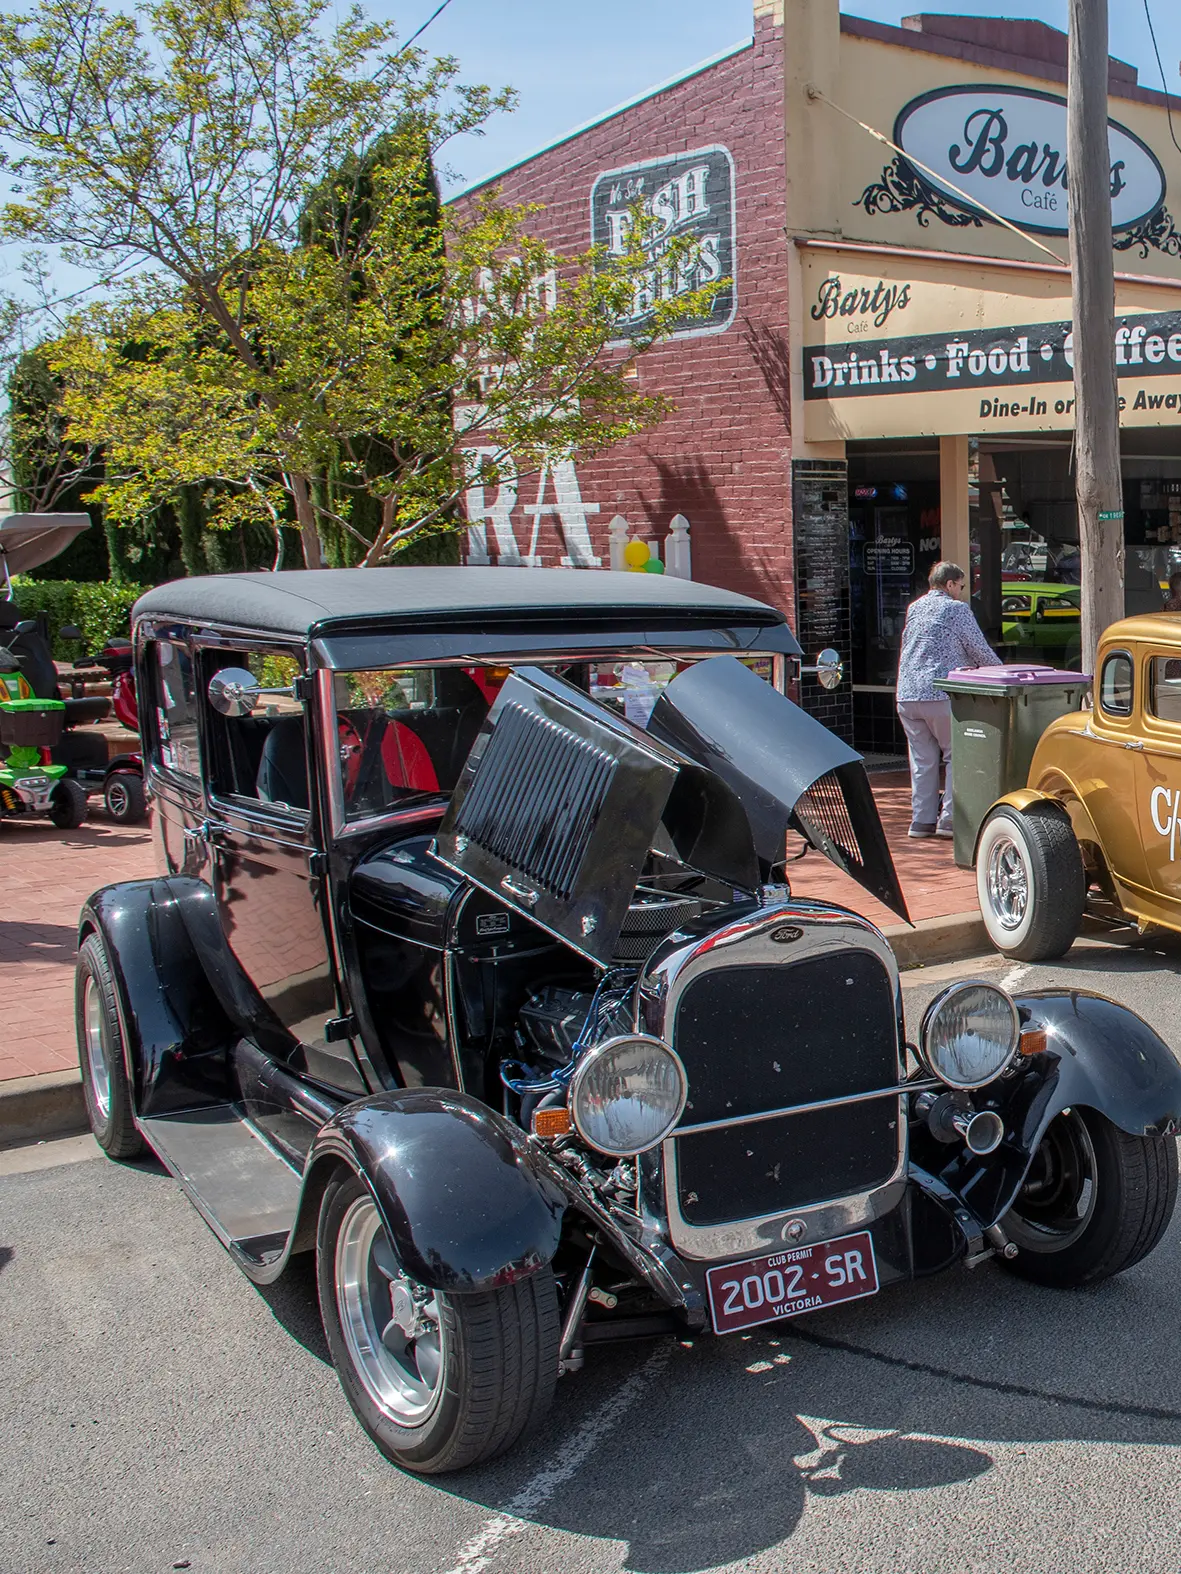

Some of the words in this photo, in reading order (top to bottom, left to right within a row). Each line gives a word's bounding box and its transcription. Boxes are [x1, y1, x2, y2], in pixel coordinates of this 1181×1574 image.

[949, 108, 1127, 207] Bars
[1021, 189, 1058, 212] Café
[811, 276, 911, 328] Bartys
[847, 321, 869, 334] Café
[811, 350, 917, 388] Drinks
[946, 337, 1030, 378] Food
[980, 396, 1047, 418] Dine-In
[1054, 398, 1075, 415] or
[875, 535, 901, 547] Bartys
[774, 928, 800, 940] Ford
[767, 1254, 787, 1268] CLUB
[787, 1248, 813, 1263] PERMIT
[772, 1295, 823, 1316] VICTORIA
